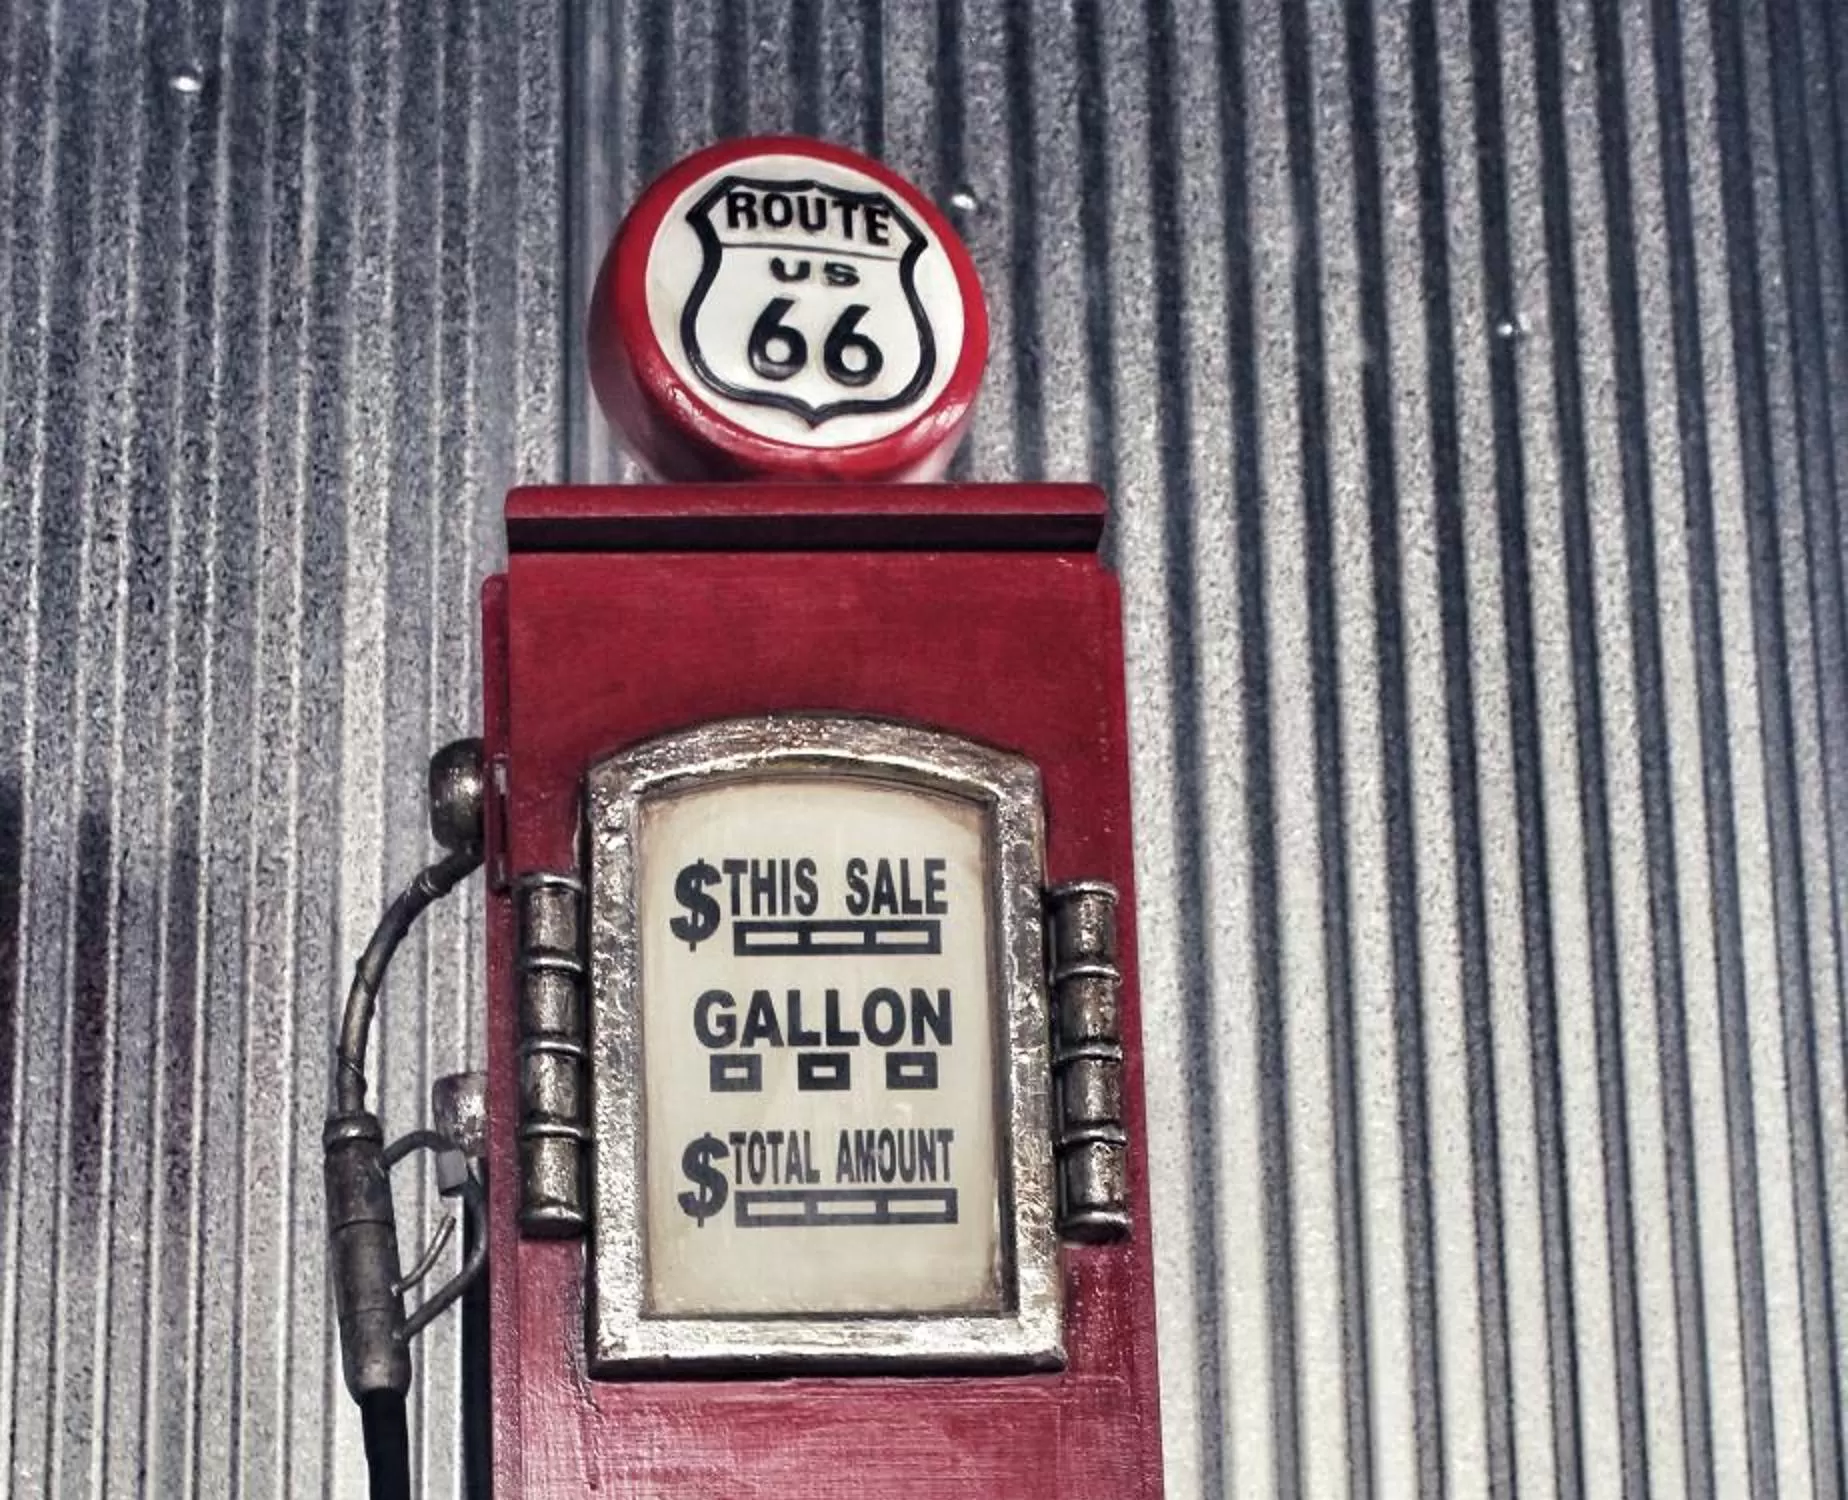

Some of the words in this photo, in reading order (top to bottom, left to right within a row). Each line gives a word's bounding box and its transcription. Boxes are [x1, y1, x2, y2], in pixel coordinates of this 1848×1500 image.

[726, 191, 891, 246] ROUTE
[769, 257, 861, 288] US
[747, 297, 884, 388] 66
[845, 857, 949, 917] SALE
[693, 987, 954, 1049] GALLON
[835, 1128, 955, 1184] AMOUNT
